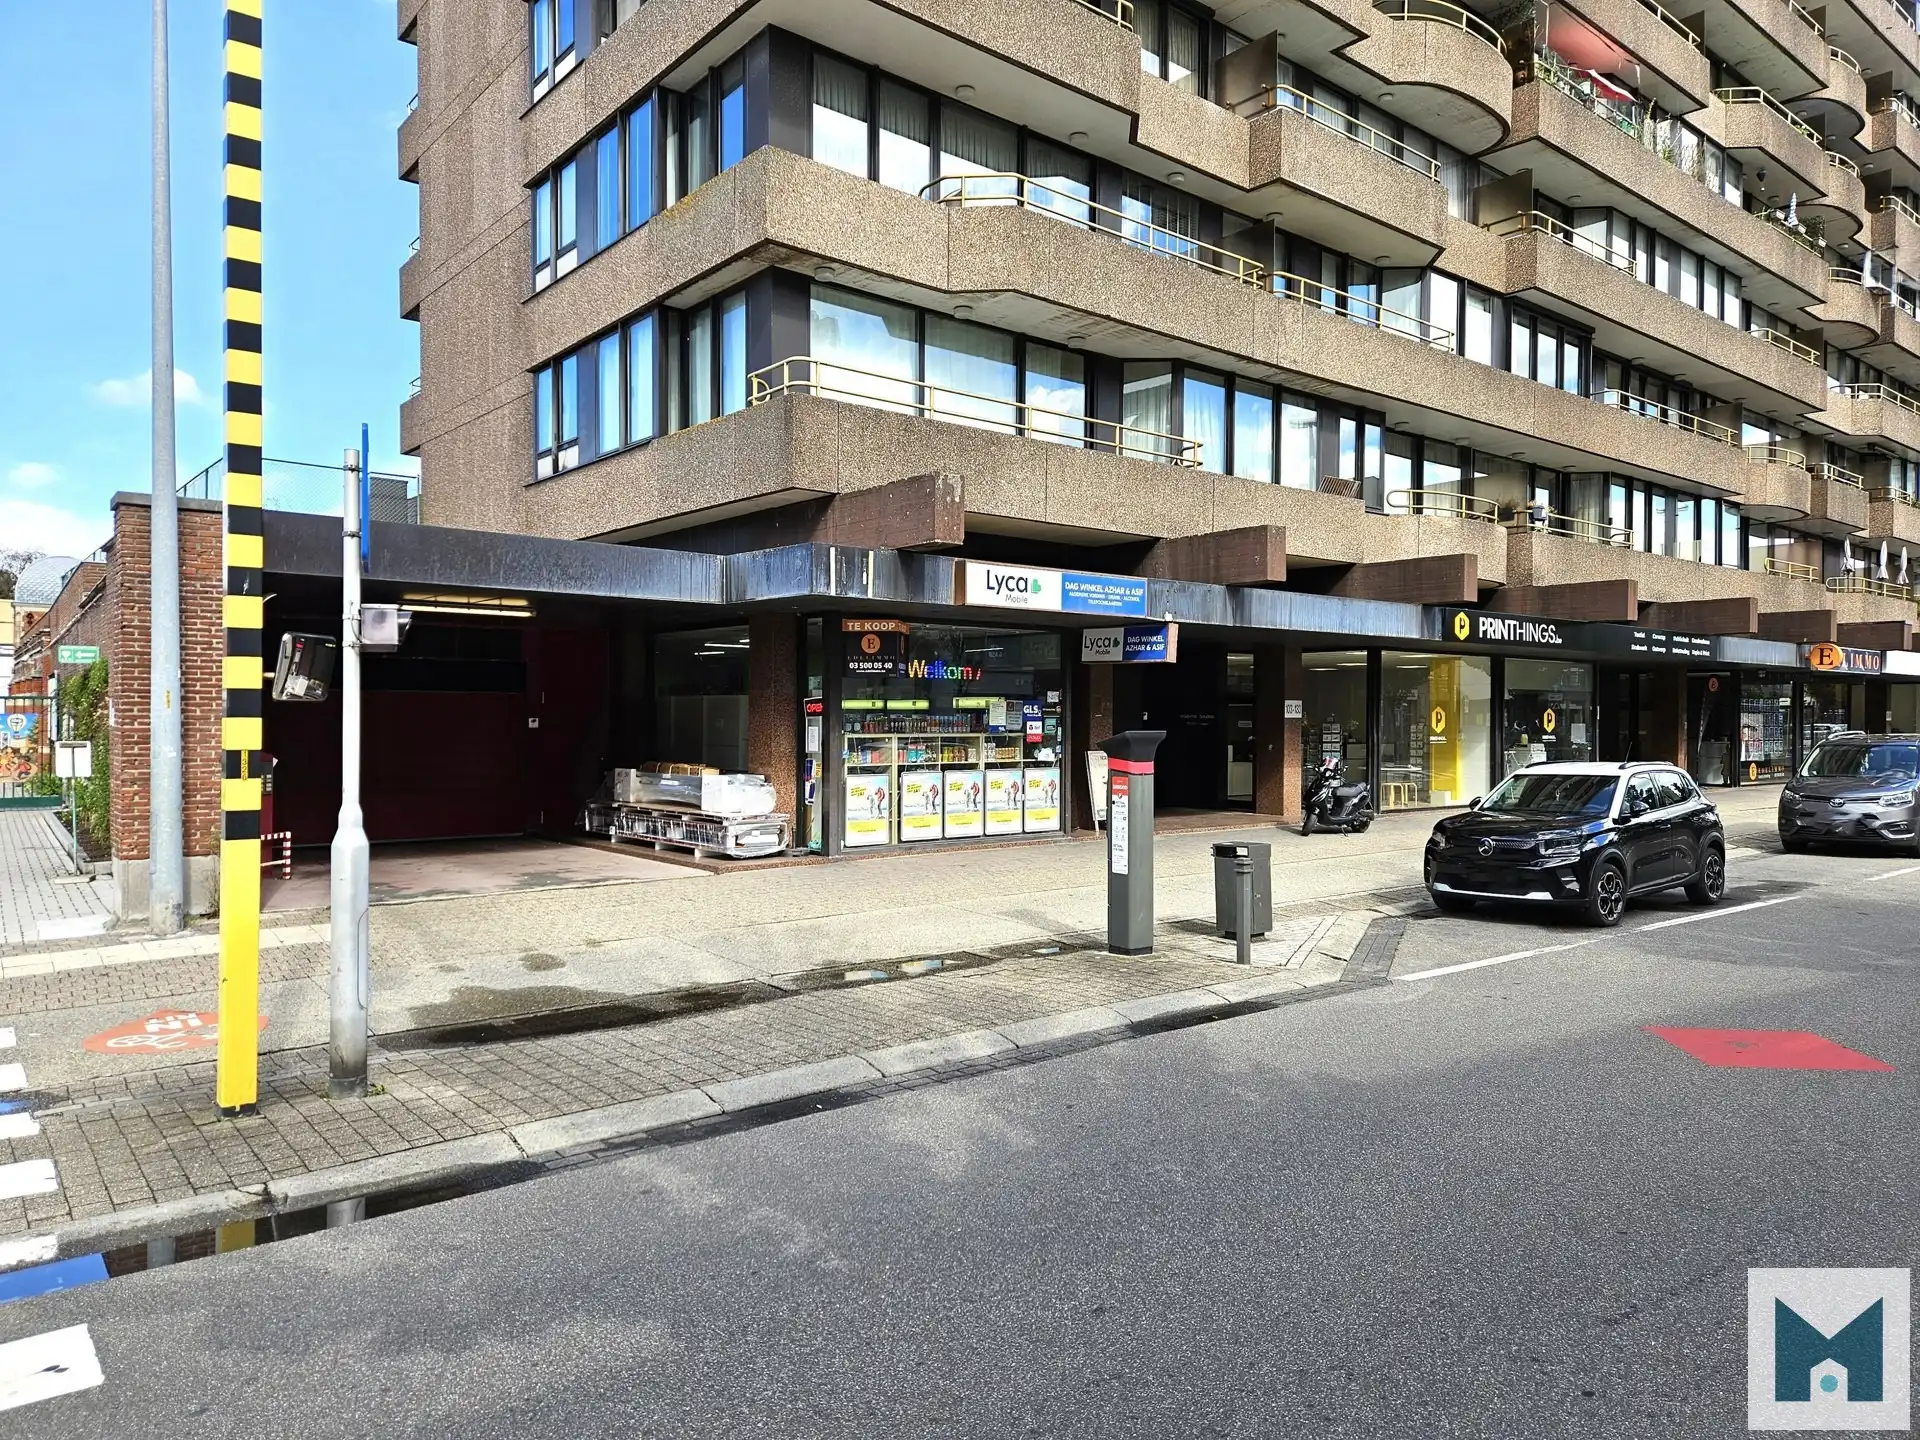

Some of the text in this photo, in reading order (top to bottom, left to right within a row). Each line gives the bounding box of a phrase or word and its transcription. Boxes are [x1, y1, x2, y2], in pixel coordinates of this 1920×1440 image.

[986, 569, 1028, 594] Lyca
[1065, 582, 1079, 590] DAG
[1080, 583, 1103, 593] WINKEL
[1104, 585, 1125, 595] AZHAR
[1131, 588, 1144, 596] ASIF
[1005, 594, 1028, 604] Mobile
[846, 622, 861, 631] TE
[864, 622, 896, 631] KOOP
[1083, 635, 1111, 651] Lyca
[1140, 635, 1164, 643] WINKEL
[1125, 644, 1146, 652] AZHAR
[1152, 643, 1165, 651] ASIF
[1816, 647, 1834, 666] E
[908, 659, 973, 680] Welkom
[1023, 705, 1039, 714] GLS
